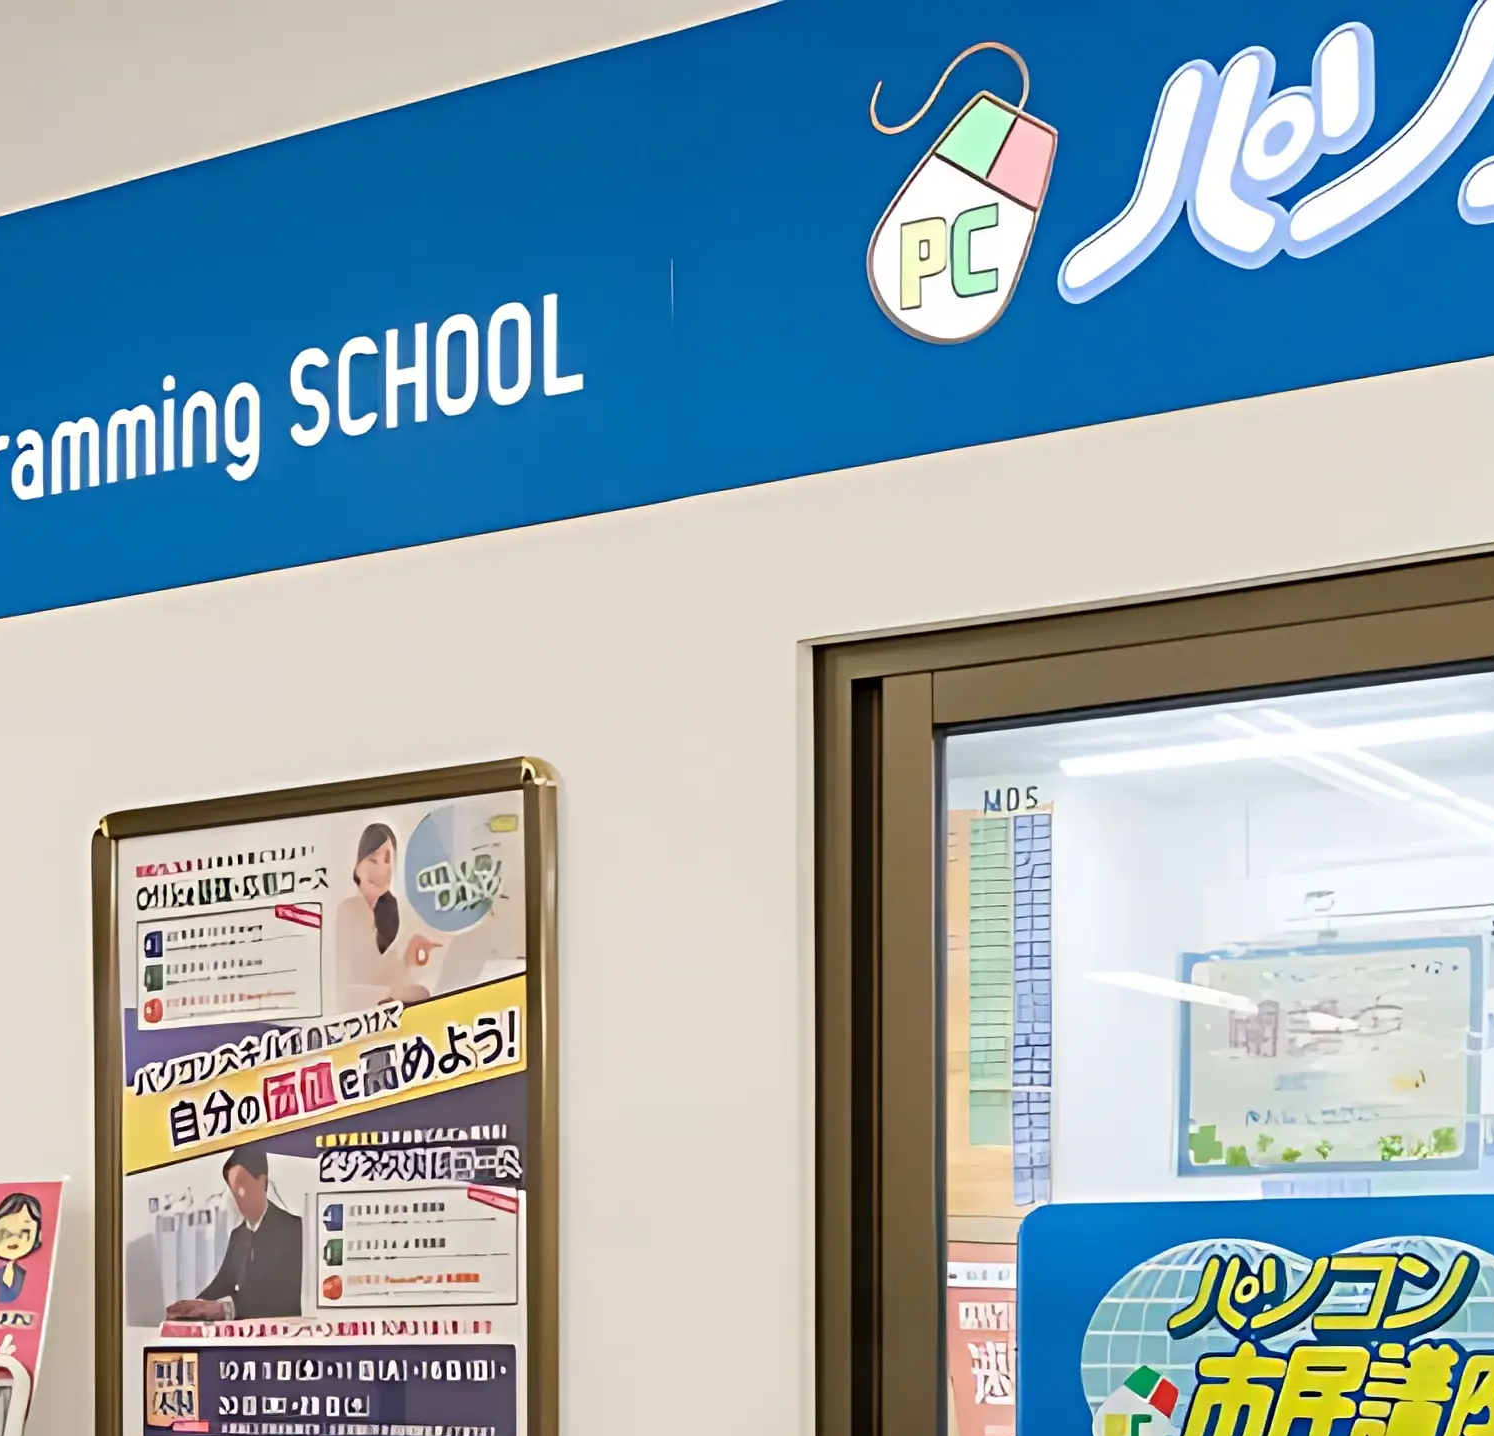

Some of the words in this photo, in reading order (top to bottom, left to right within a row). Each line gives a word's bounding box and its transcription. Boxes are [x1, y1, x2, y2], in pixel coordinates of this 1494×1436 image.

[899, 204, 1000, 311] PC
[289, 293, 586, 448] SCHOOL
[1169, 1252, 1475, 1334] パソコン
